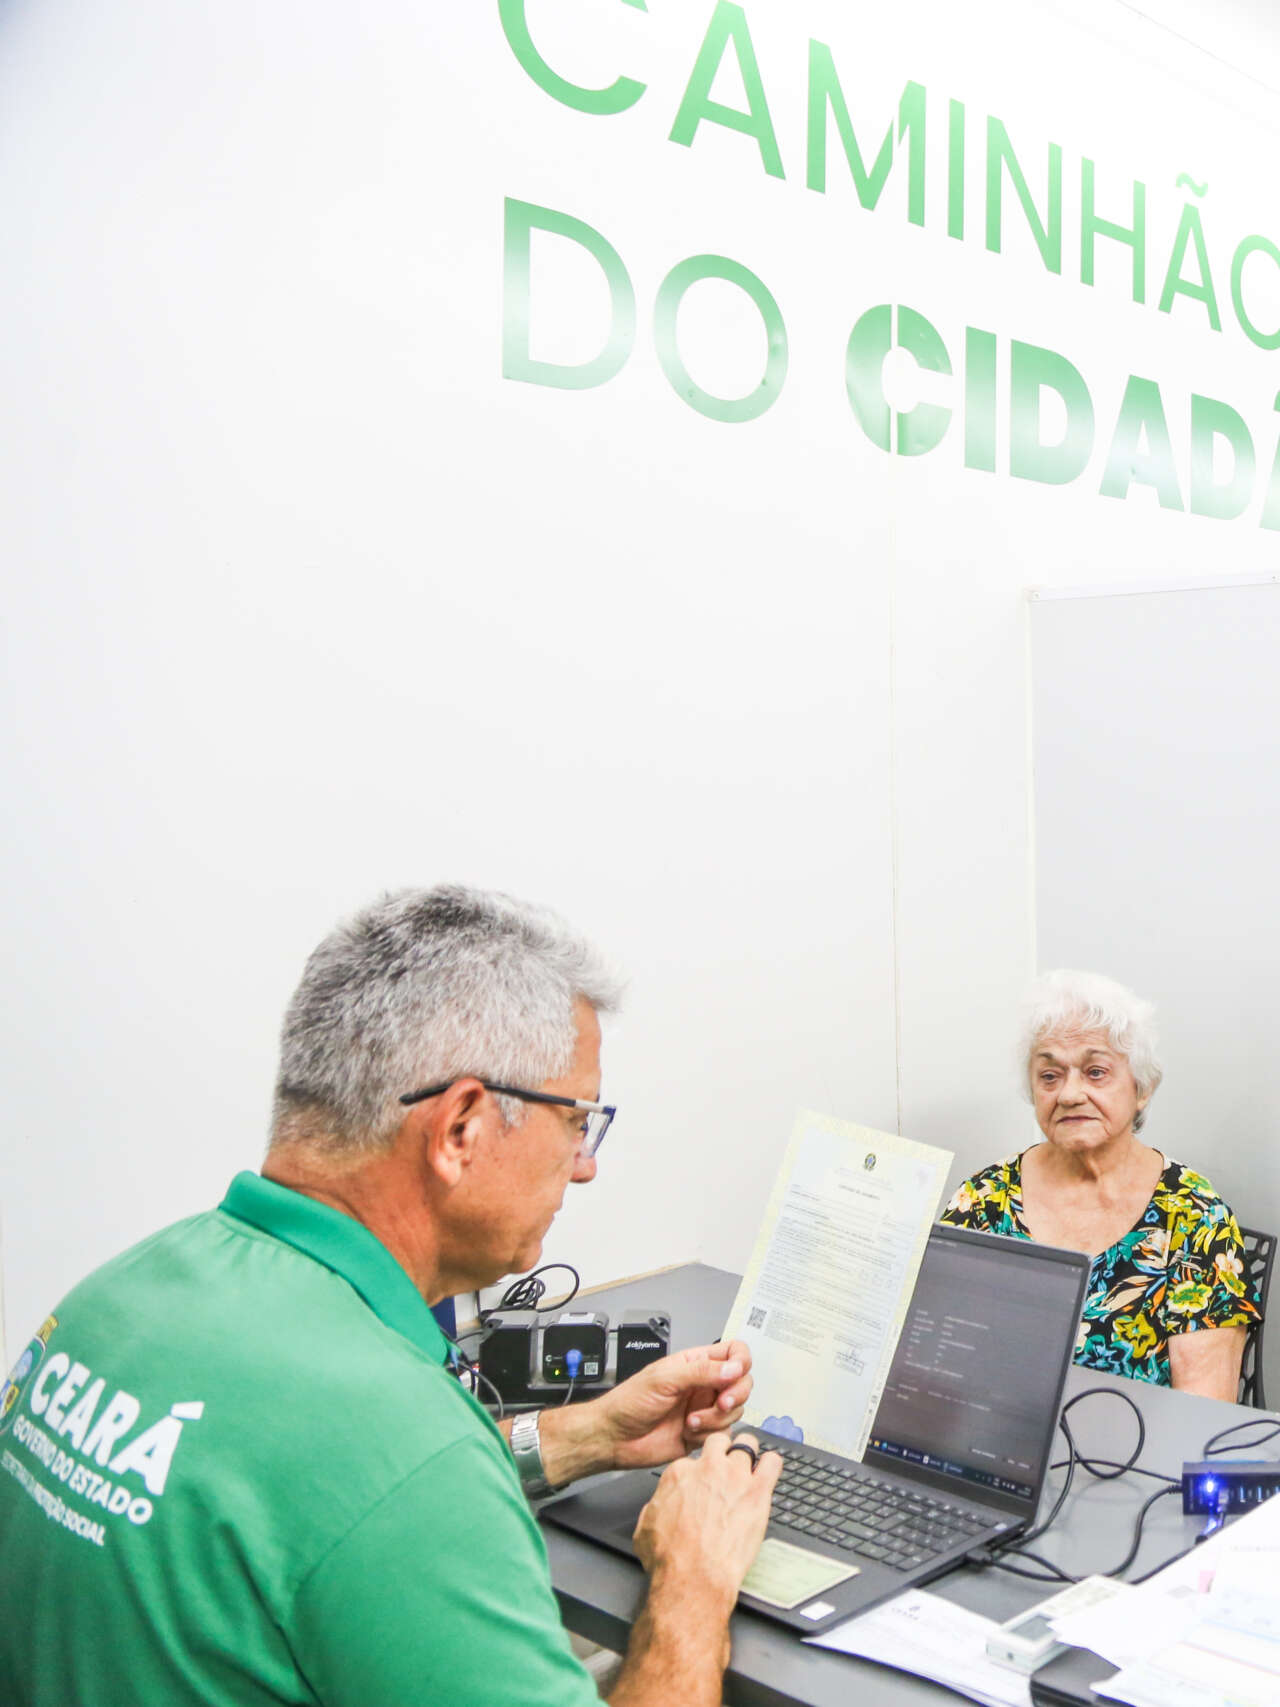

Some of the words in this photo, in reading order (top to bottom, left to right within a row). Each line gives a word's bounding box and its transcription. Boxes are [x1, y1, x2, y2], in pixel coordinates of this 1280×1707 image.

[502, 196, 789, 424] DO
[30, 1352, 205, 1497] CEARÁ
[51, 1449, 75, 1482] DO
[68, 1463, 154, 1525] ESTADO
[62, 1506, 106, 1547] SOCIAL
